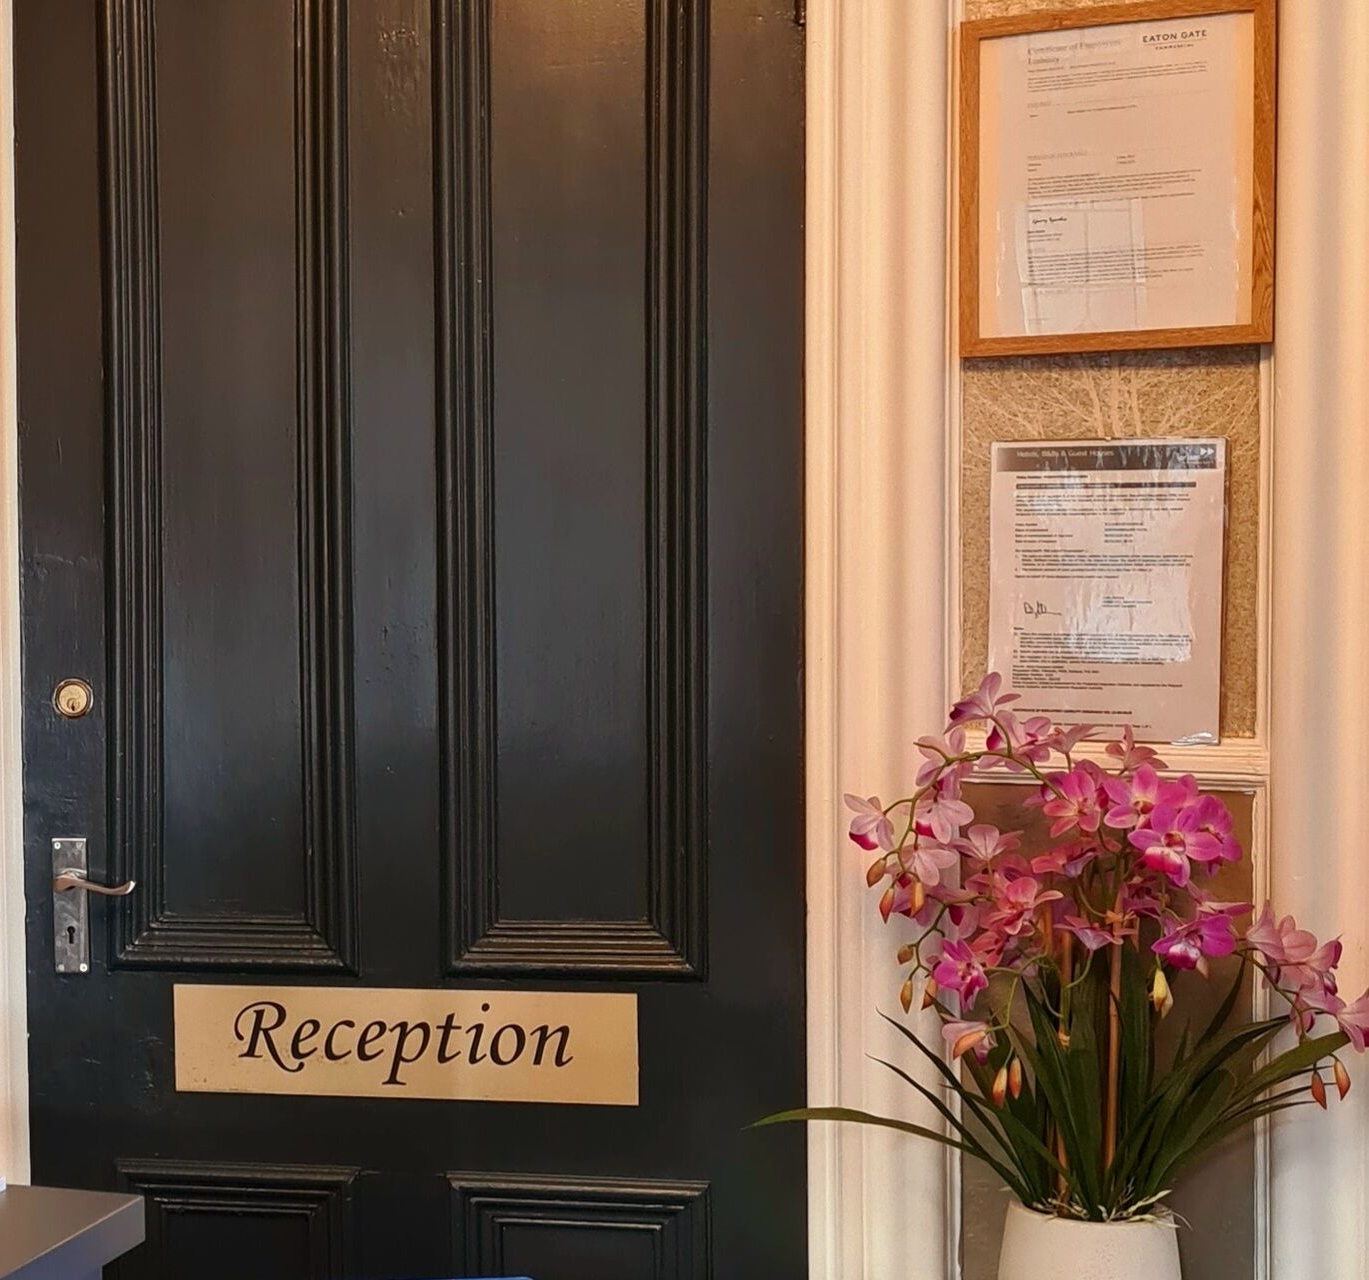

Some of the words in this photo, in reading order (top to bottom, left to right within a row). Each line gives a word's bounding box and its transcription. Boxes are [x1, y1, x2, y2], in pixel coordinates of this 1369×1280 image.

[1142, 32, 1178, 43] EATON
[1180, 29, 1208, 39] GATE
[233, 1000, 574, 1086] Reception
